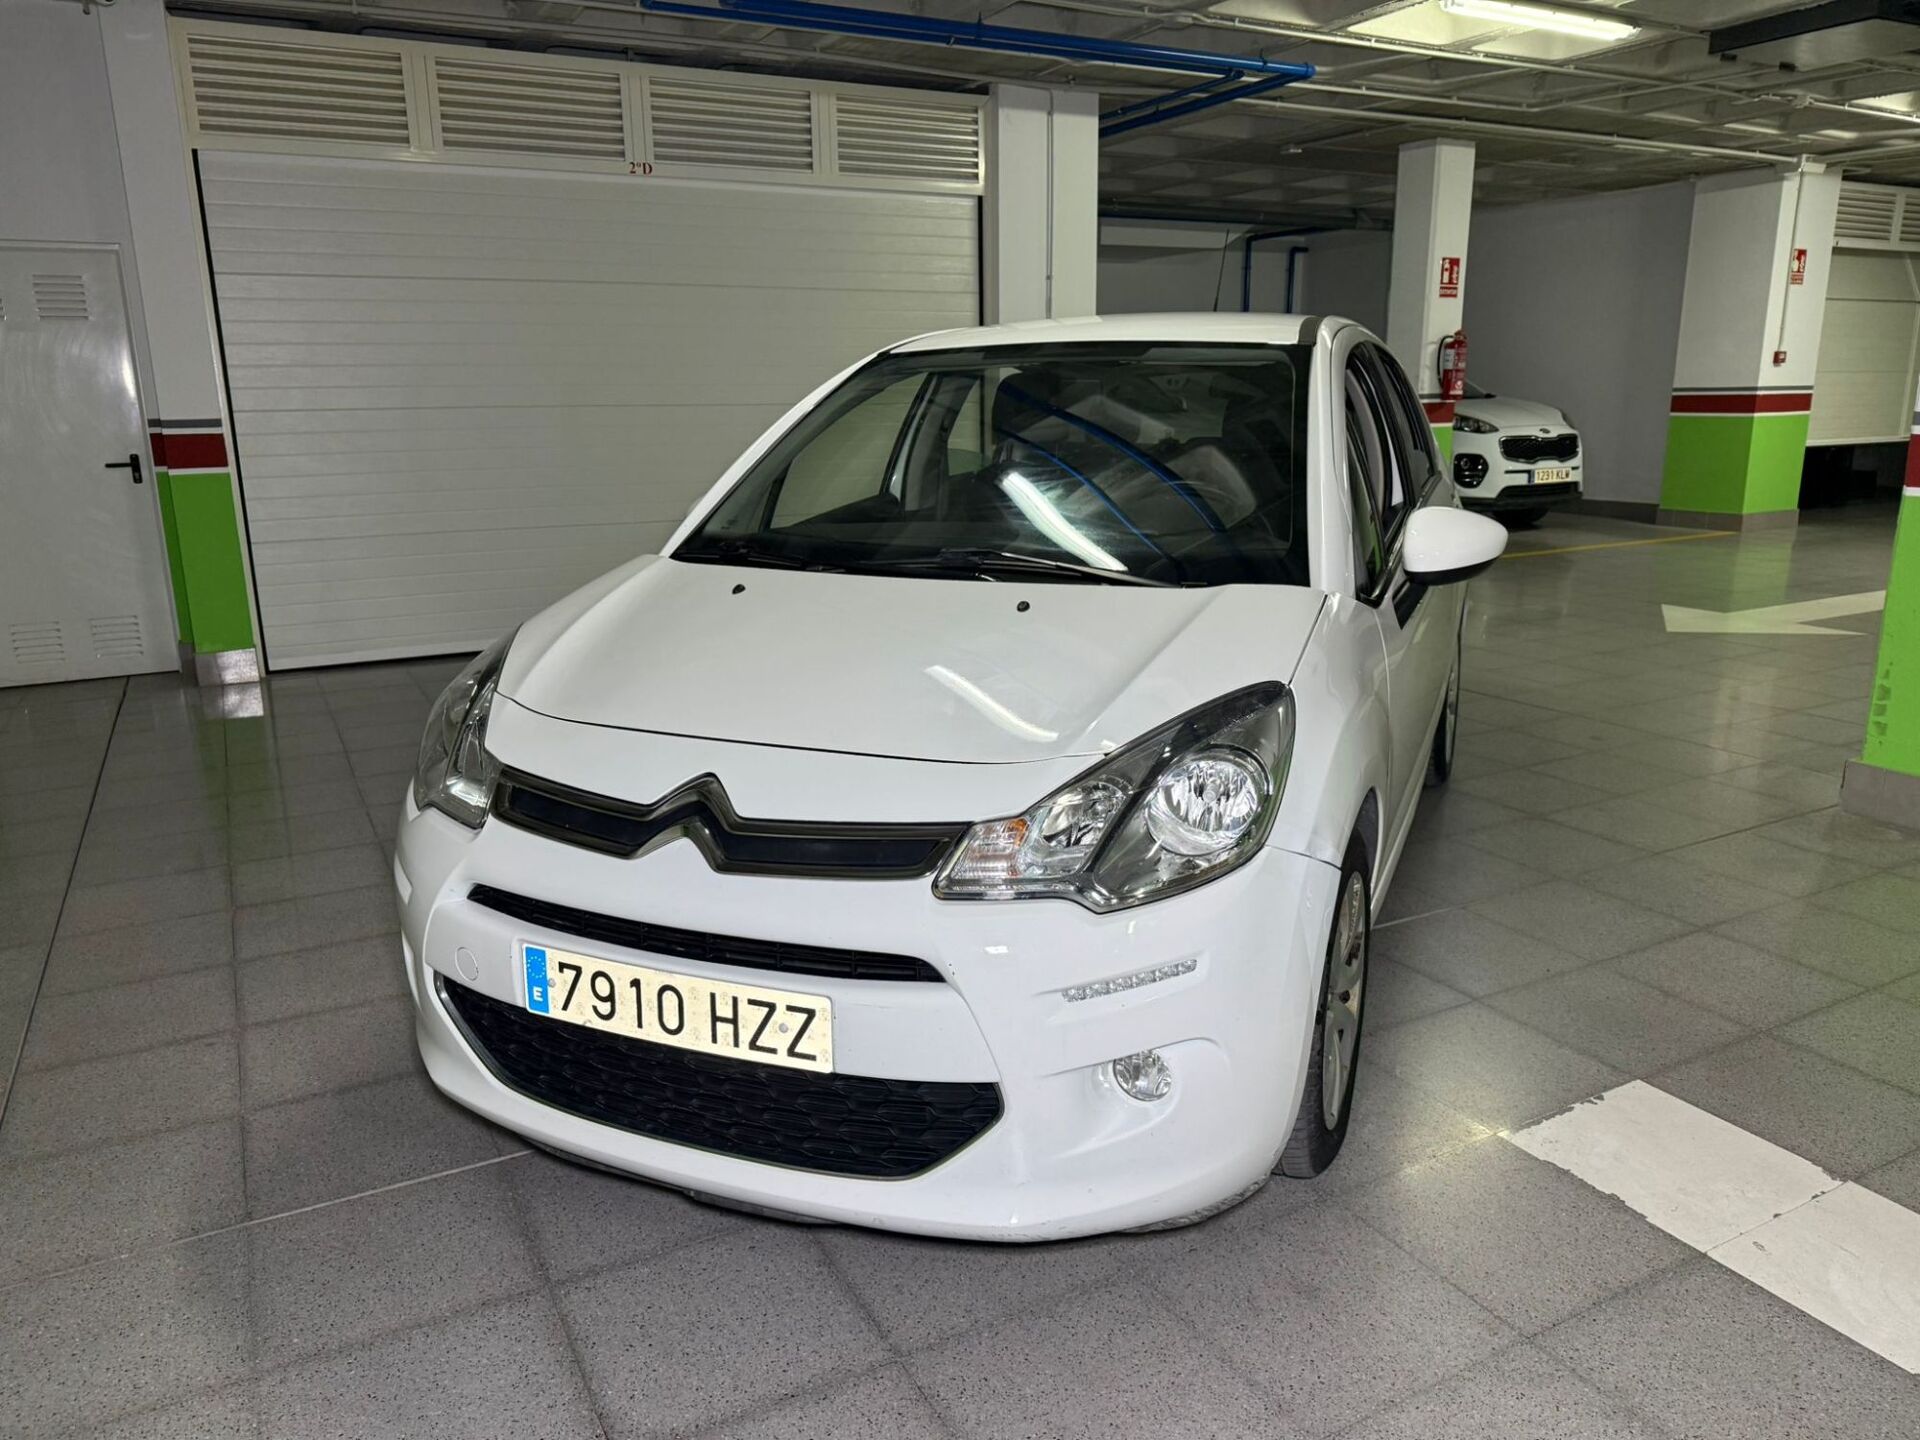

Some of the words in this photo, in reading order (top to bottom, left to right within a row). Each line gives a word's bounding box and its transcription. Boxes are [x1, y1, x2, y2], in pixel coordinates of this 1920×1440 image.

[533, 987, 543, 1001] E
[558, 961, 685, 1036] 7910
[709, 992, 817, 1062] HZZ
